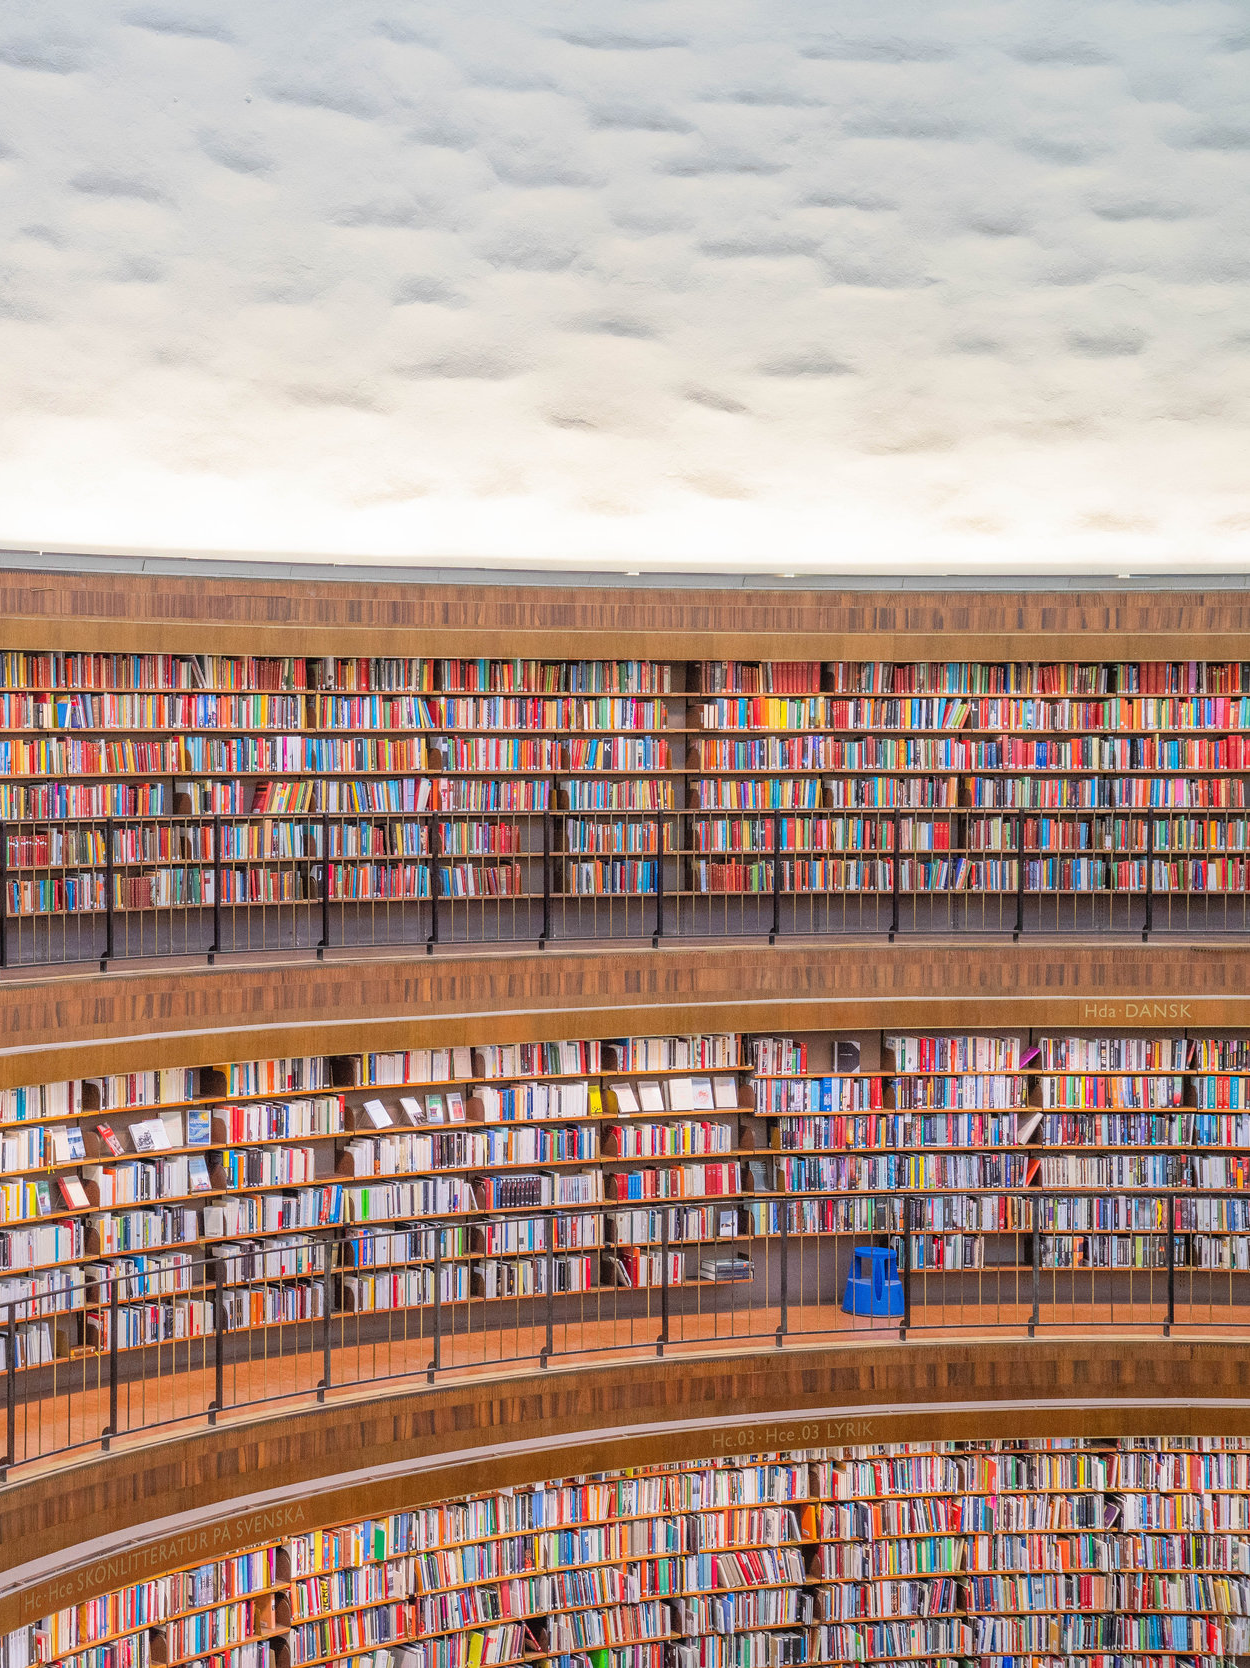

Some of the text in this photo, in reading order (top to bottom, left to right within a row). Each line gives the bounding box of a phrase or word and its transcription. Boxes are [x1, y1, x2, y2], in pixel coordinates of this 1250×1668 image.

[604, 744, 612, 752] K
[827, 1421, 873, 1439] LYRIK
[77, 1534, 208, 1590] SKÖNLITTERATUR
[213, 1522, 231, 1546] PÅ
[236, 1504, 306, 1539] SVENSKA
